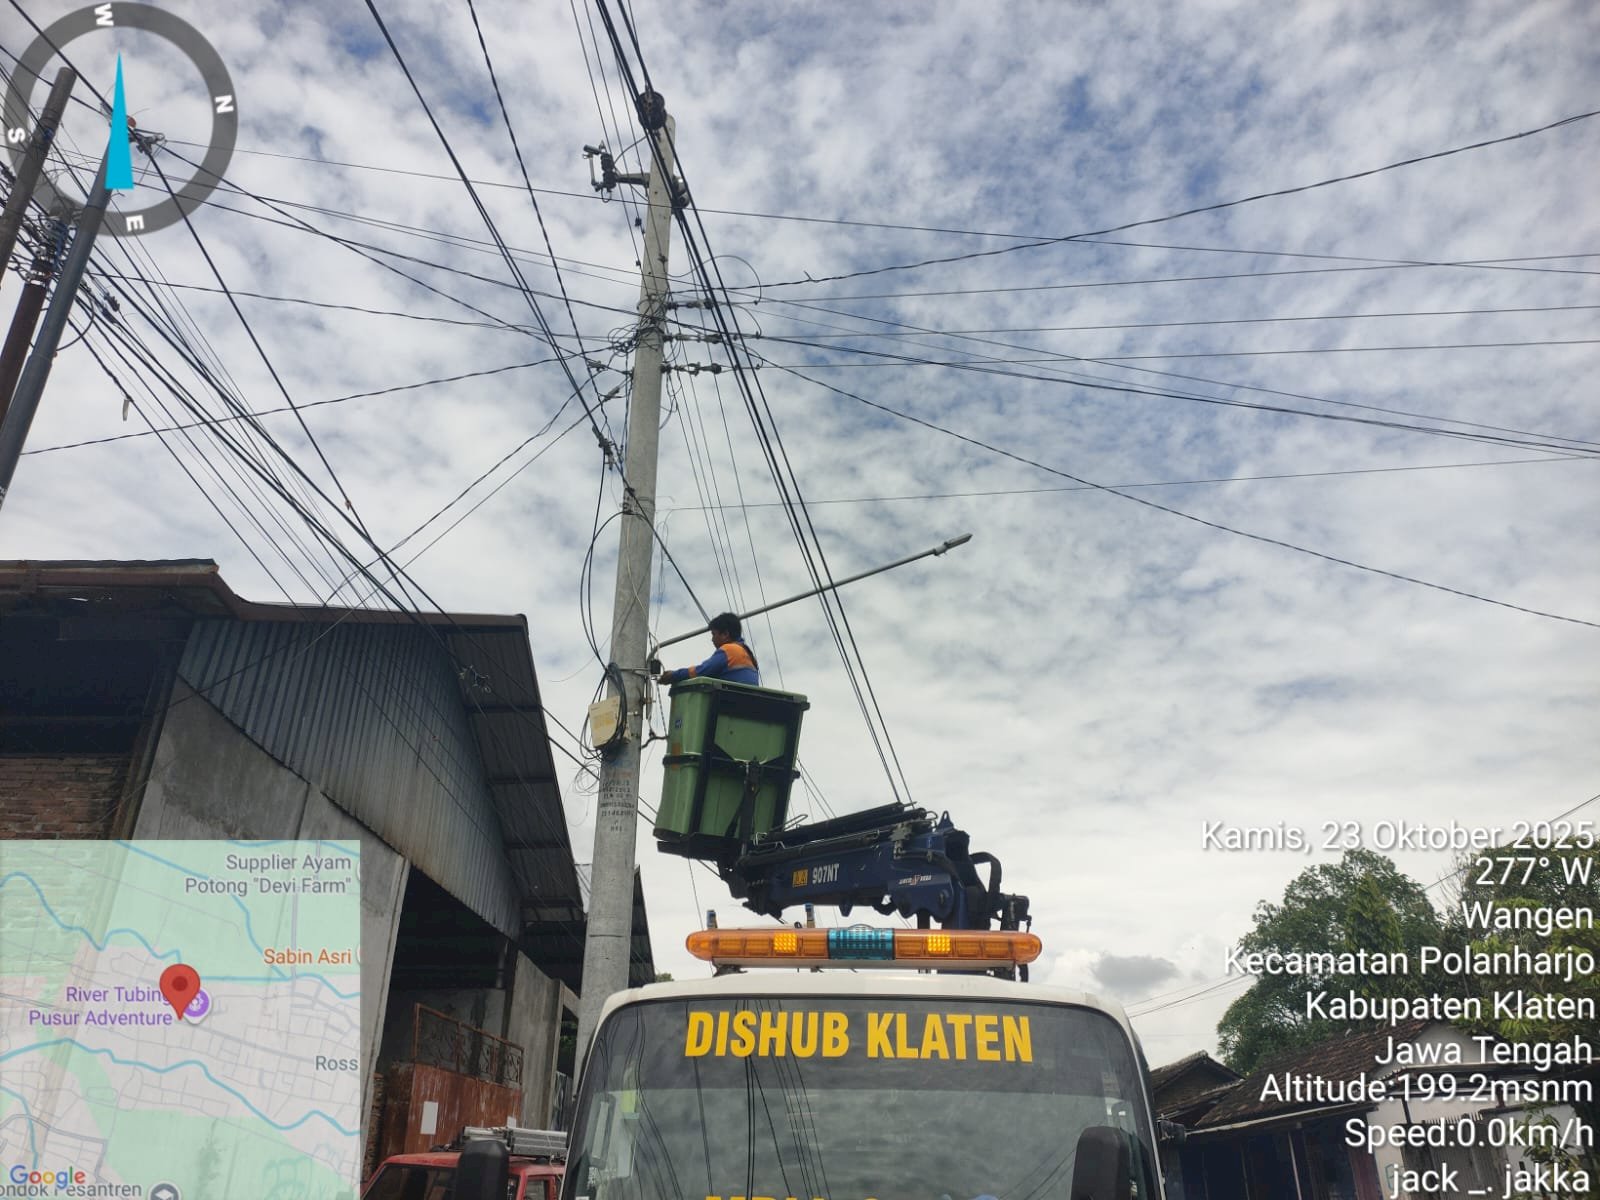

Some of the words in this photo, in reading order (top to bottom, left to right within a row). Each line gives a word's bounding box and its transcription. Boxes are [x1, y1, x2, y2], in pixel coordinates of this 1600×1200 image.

[812, 863, 840, 884] 907NT
[684, 1010, 850, 1058] DISHUB
[867, 1012, 1033, 1063] KLATEN
